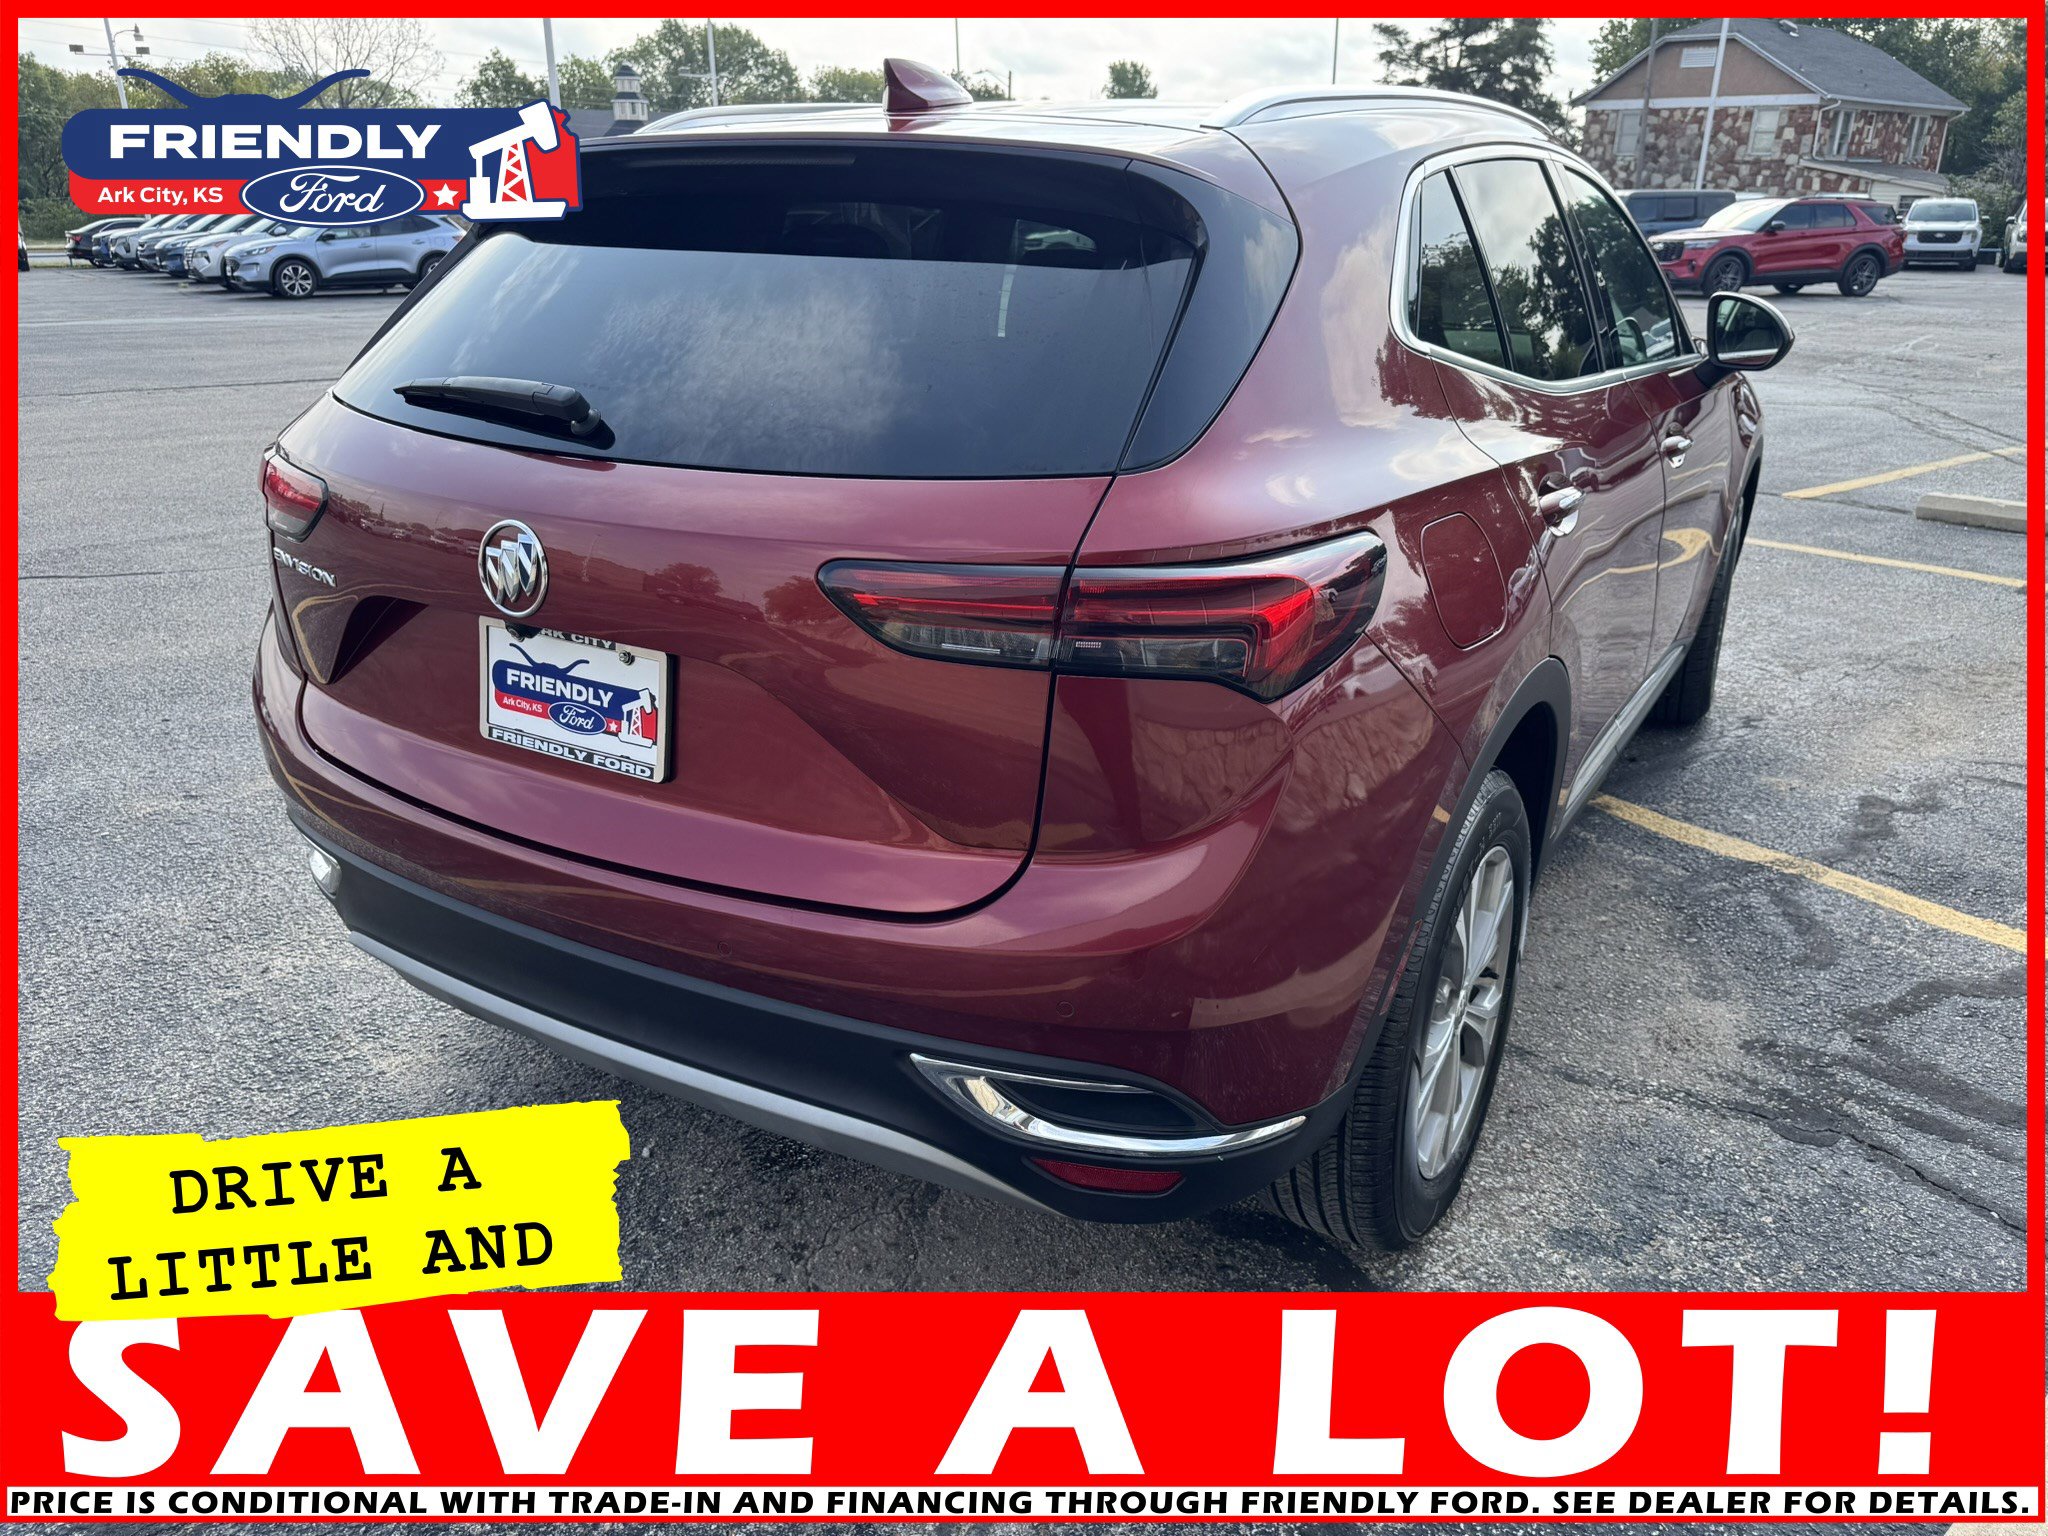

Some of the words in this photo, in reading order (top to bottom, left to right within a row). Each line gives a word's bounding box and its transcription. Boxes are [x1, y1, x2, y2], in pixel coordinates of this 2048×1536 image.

[273, 546, 337, 587] ENVISION
[540, 627, 566, 640] RK
[570, 633, 613, 649] CITY
[502, 695, 516, 706] Ark
[516, 698, 532, 711] City,
[532, 702, 543, 713] KS
[506, 668, 614, 708] FRIENDLY
[559, 704, 595, 730] Ford
[491, 728, 588, 762] FRIENDLY
[593, 754, 652, 778] FORD
